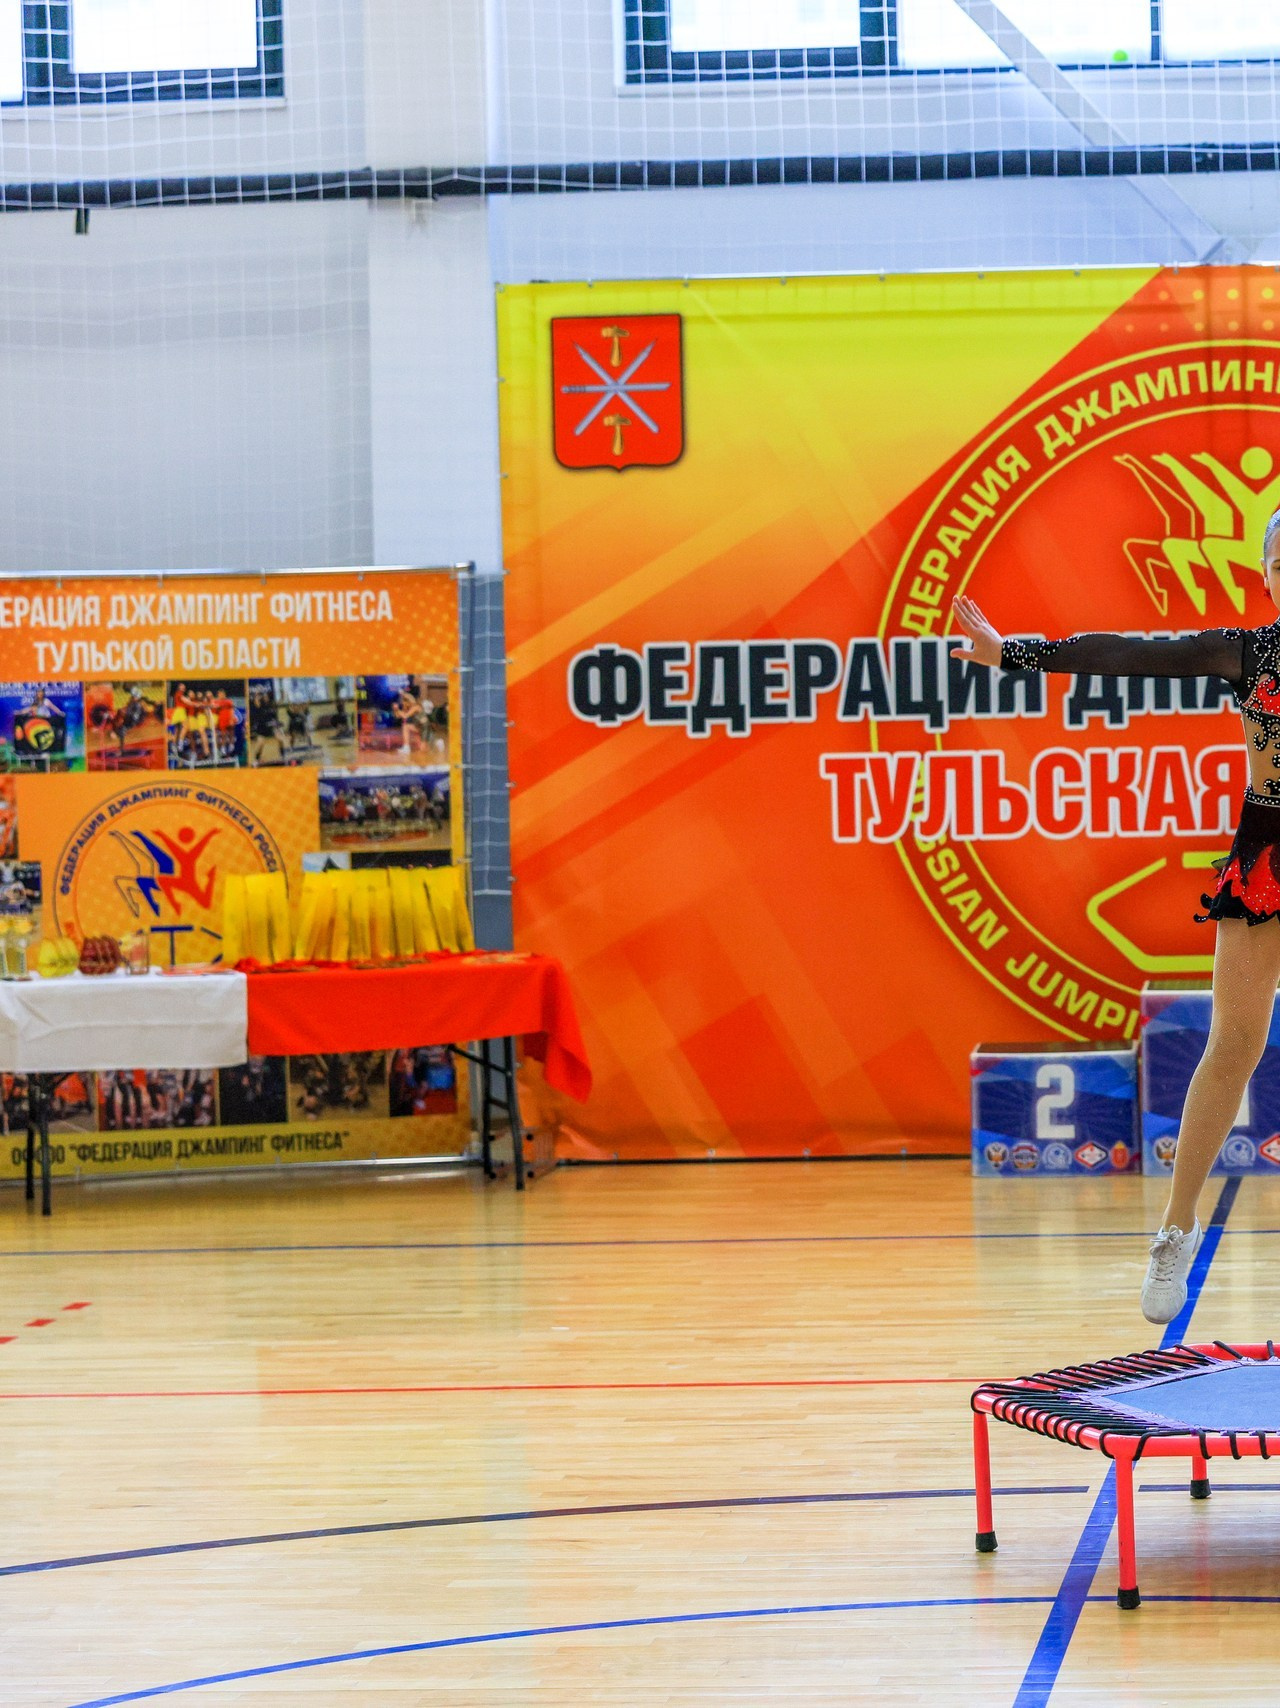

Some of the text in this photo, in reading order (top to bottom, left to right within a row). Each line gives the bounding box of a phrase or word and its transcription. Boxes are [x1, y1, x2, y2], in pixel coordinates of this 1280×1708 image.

[901, 445, 1031, 637] ДЕРАЦИЯ
[107, 592, 264, 630] ДЖАМПИНГ
[270, 589, 394, 626] ФИТНЕСА
[33, 634, 301, 673] ТУЛЬСКОЙ ОБЛАСТИ
[822, 746, 1248, 843] ТУЛЬСКАЯ
[60, 813, 107, 896] ФЕДЕРАЦИЯ
[107, 787, 192, 818] ДЖАМПИНГ
[196, 791, 255, 833] ФИТНЕСА
[1004, 952, 1140, 1040] JUMPI
[1036, 1064, 1076, 1139] 2
[176, 1135, 265, 1160] ДЖАМПИНГ
